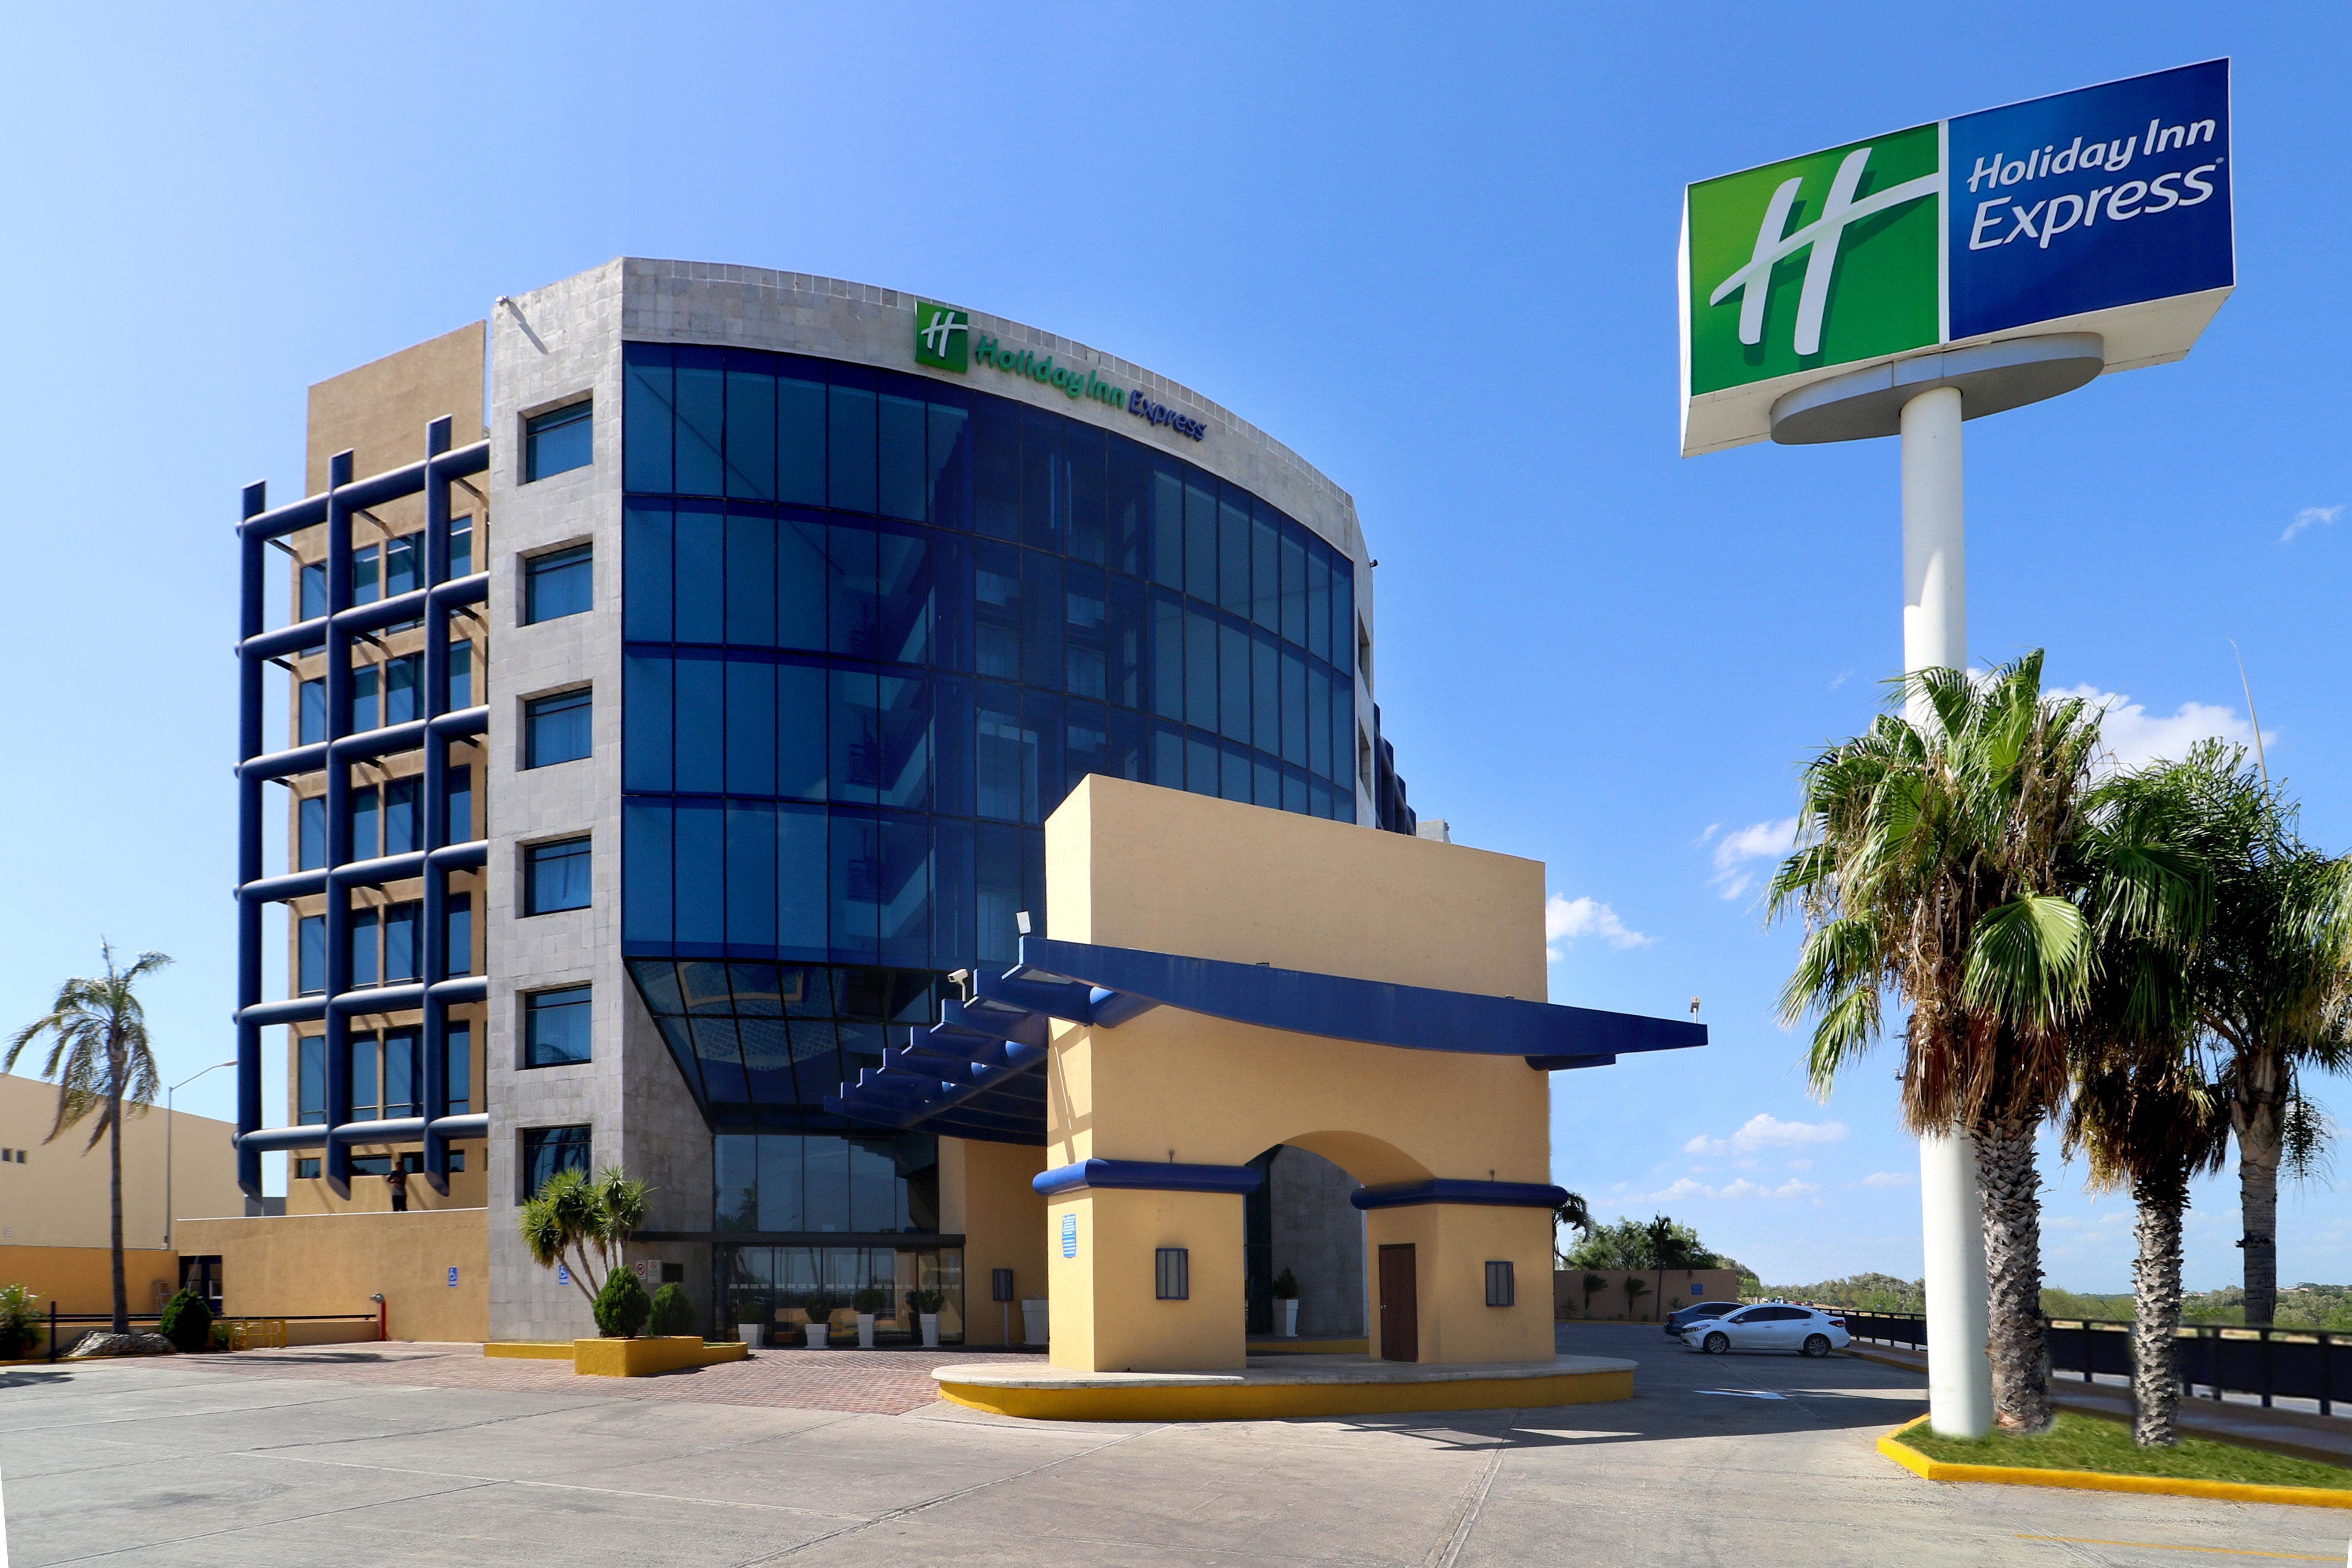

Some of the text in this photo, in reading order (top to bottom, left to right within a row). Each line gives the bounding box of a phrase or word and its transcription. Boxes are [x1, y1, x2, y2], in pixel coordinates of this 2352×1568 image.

[1966, 118, 2216, 193] Holiday Inn
[1969, 164, 2217, 251] Express
[976, 334, 1207, 442] Holiday Inn Express
